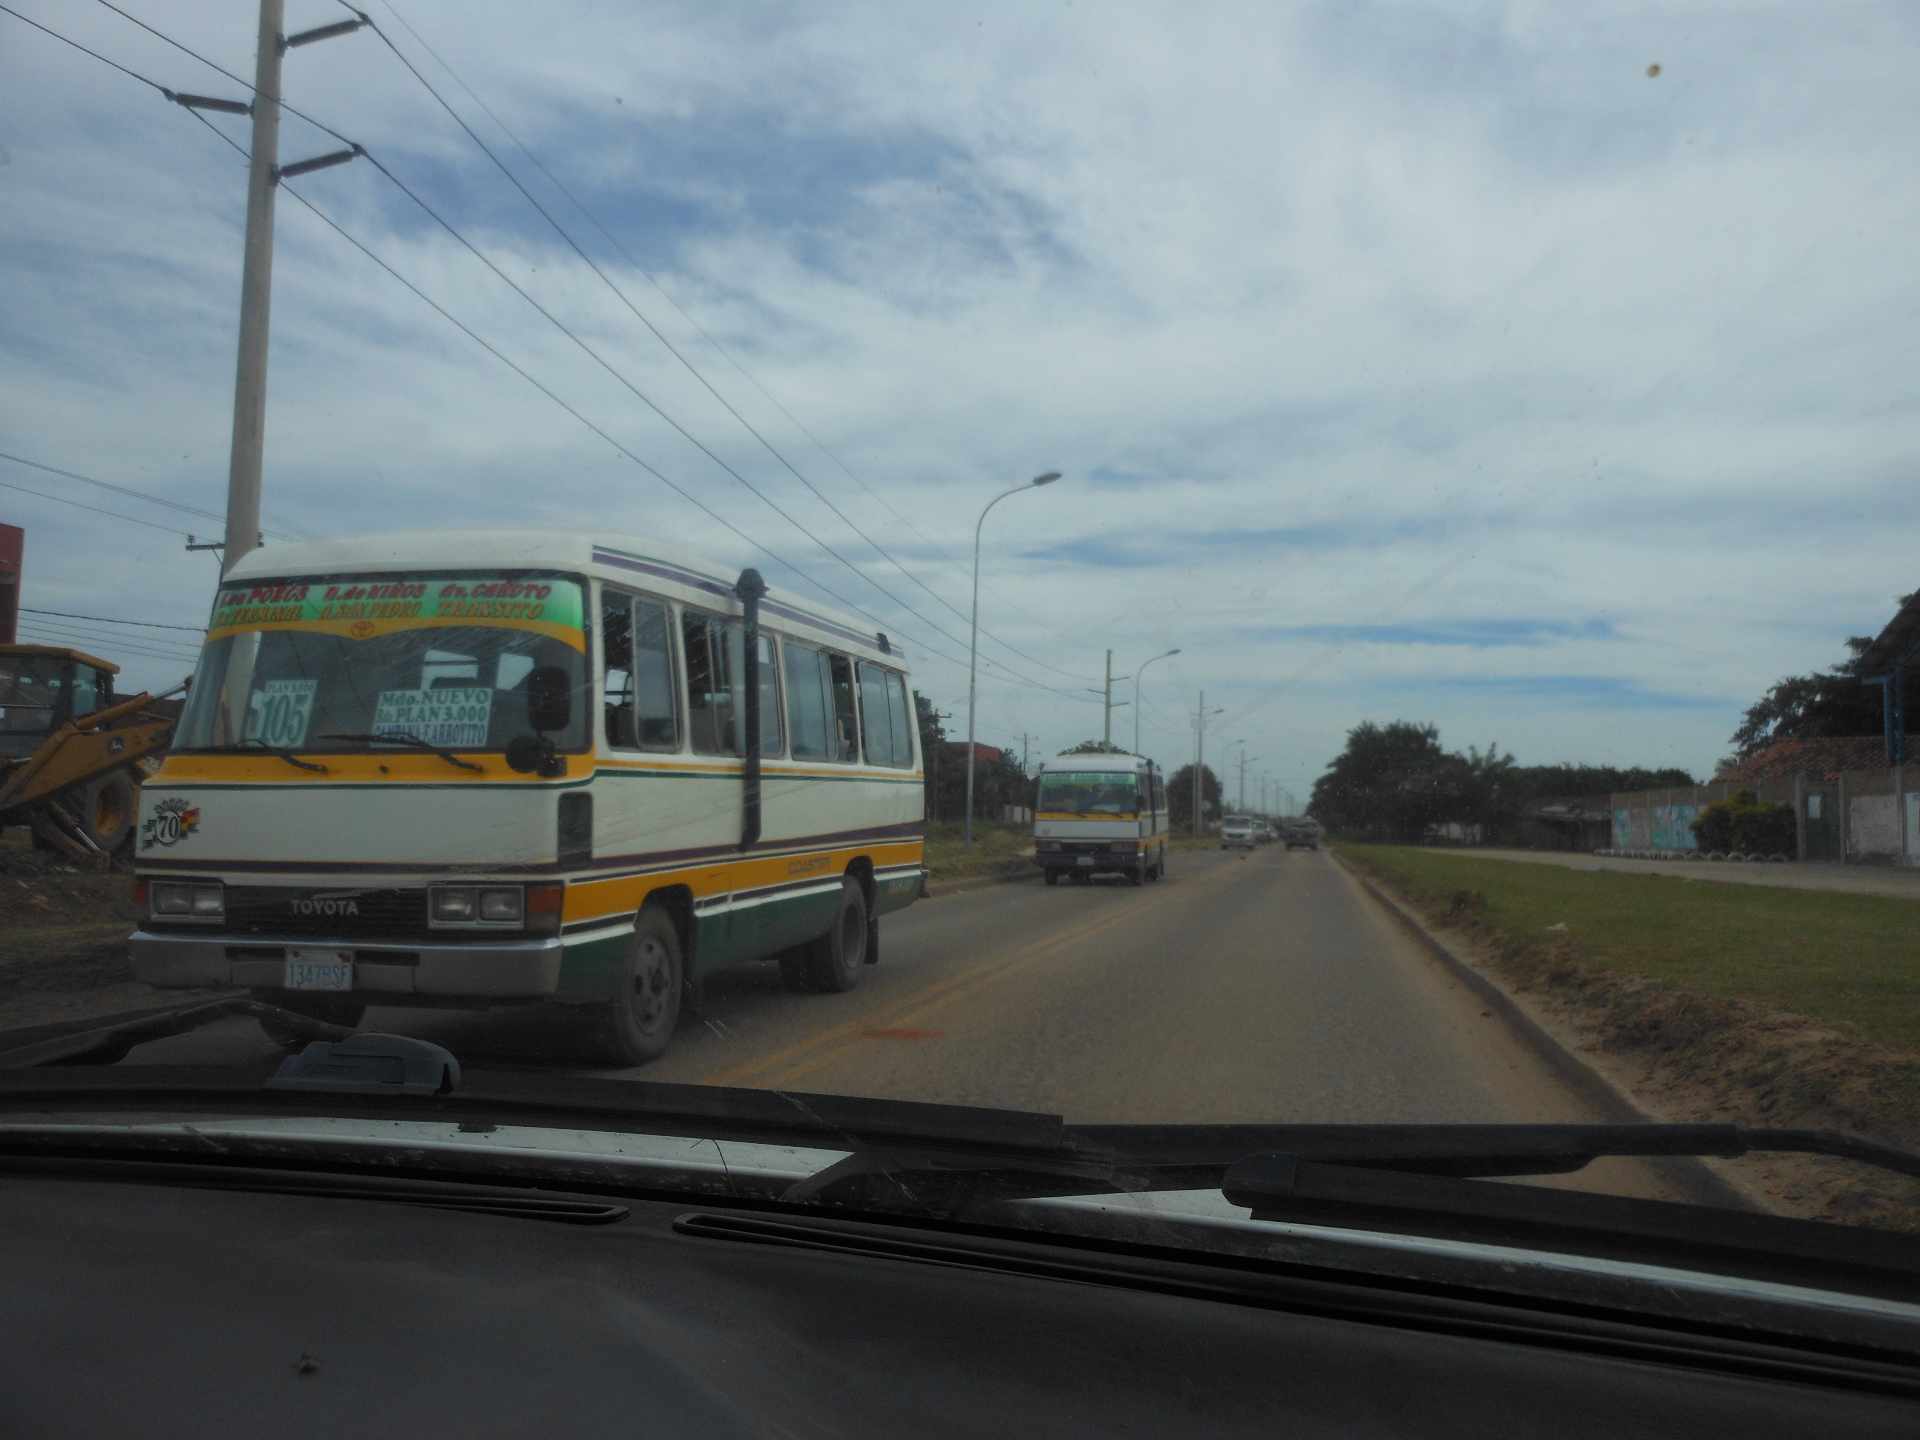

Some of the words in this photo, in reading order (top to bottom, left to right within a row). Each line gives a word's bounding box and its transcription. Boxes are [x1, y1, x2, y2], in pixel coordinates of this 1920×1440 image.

[422, 689, 489, 705] NUEVO
[397, 706, 439, 722] PLAN
[159, 815, 179, 839] 70
[290, 899, 359, 916] TOYOTA
